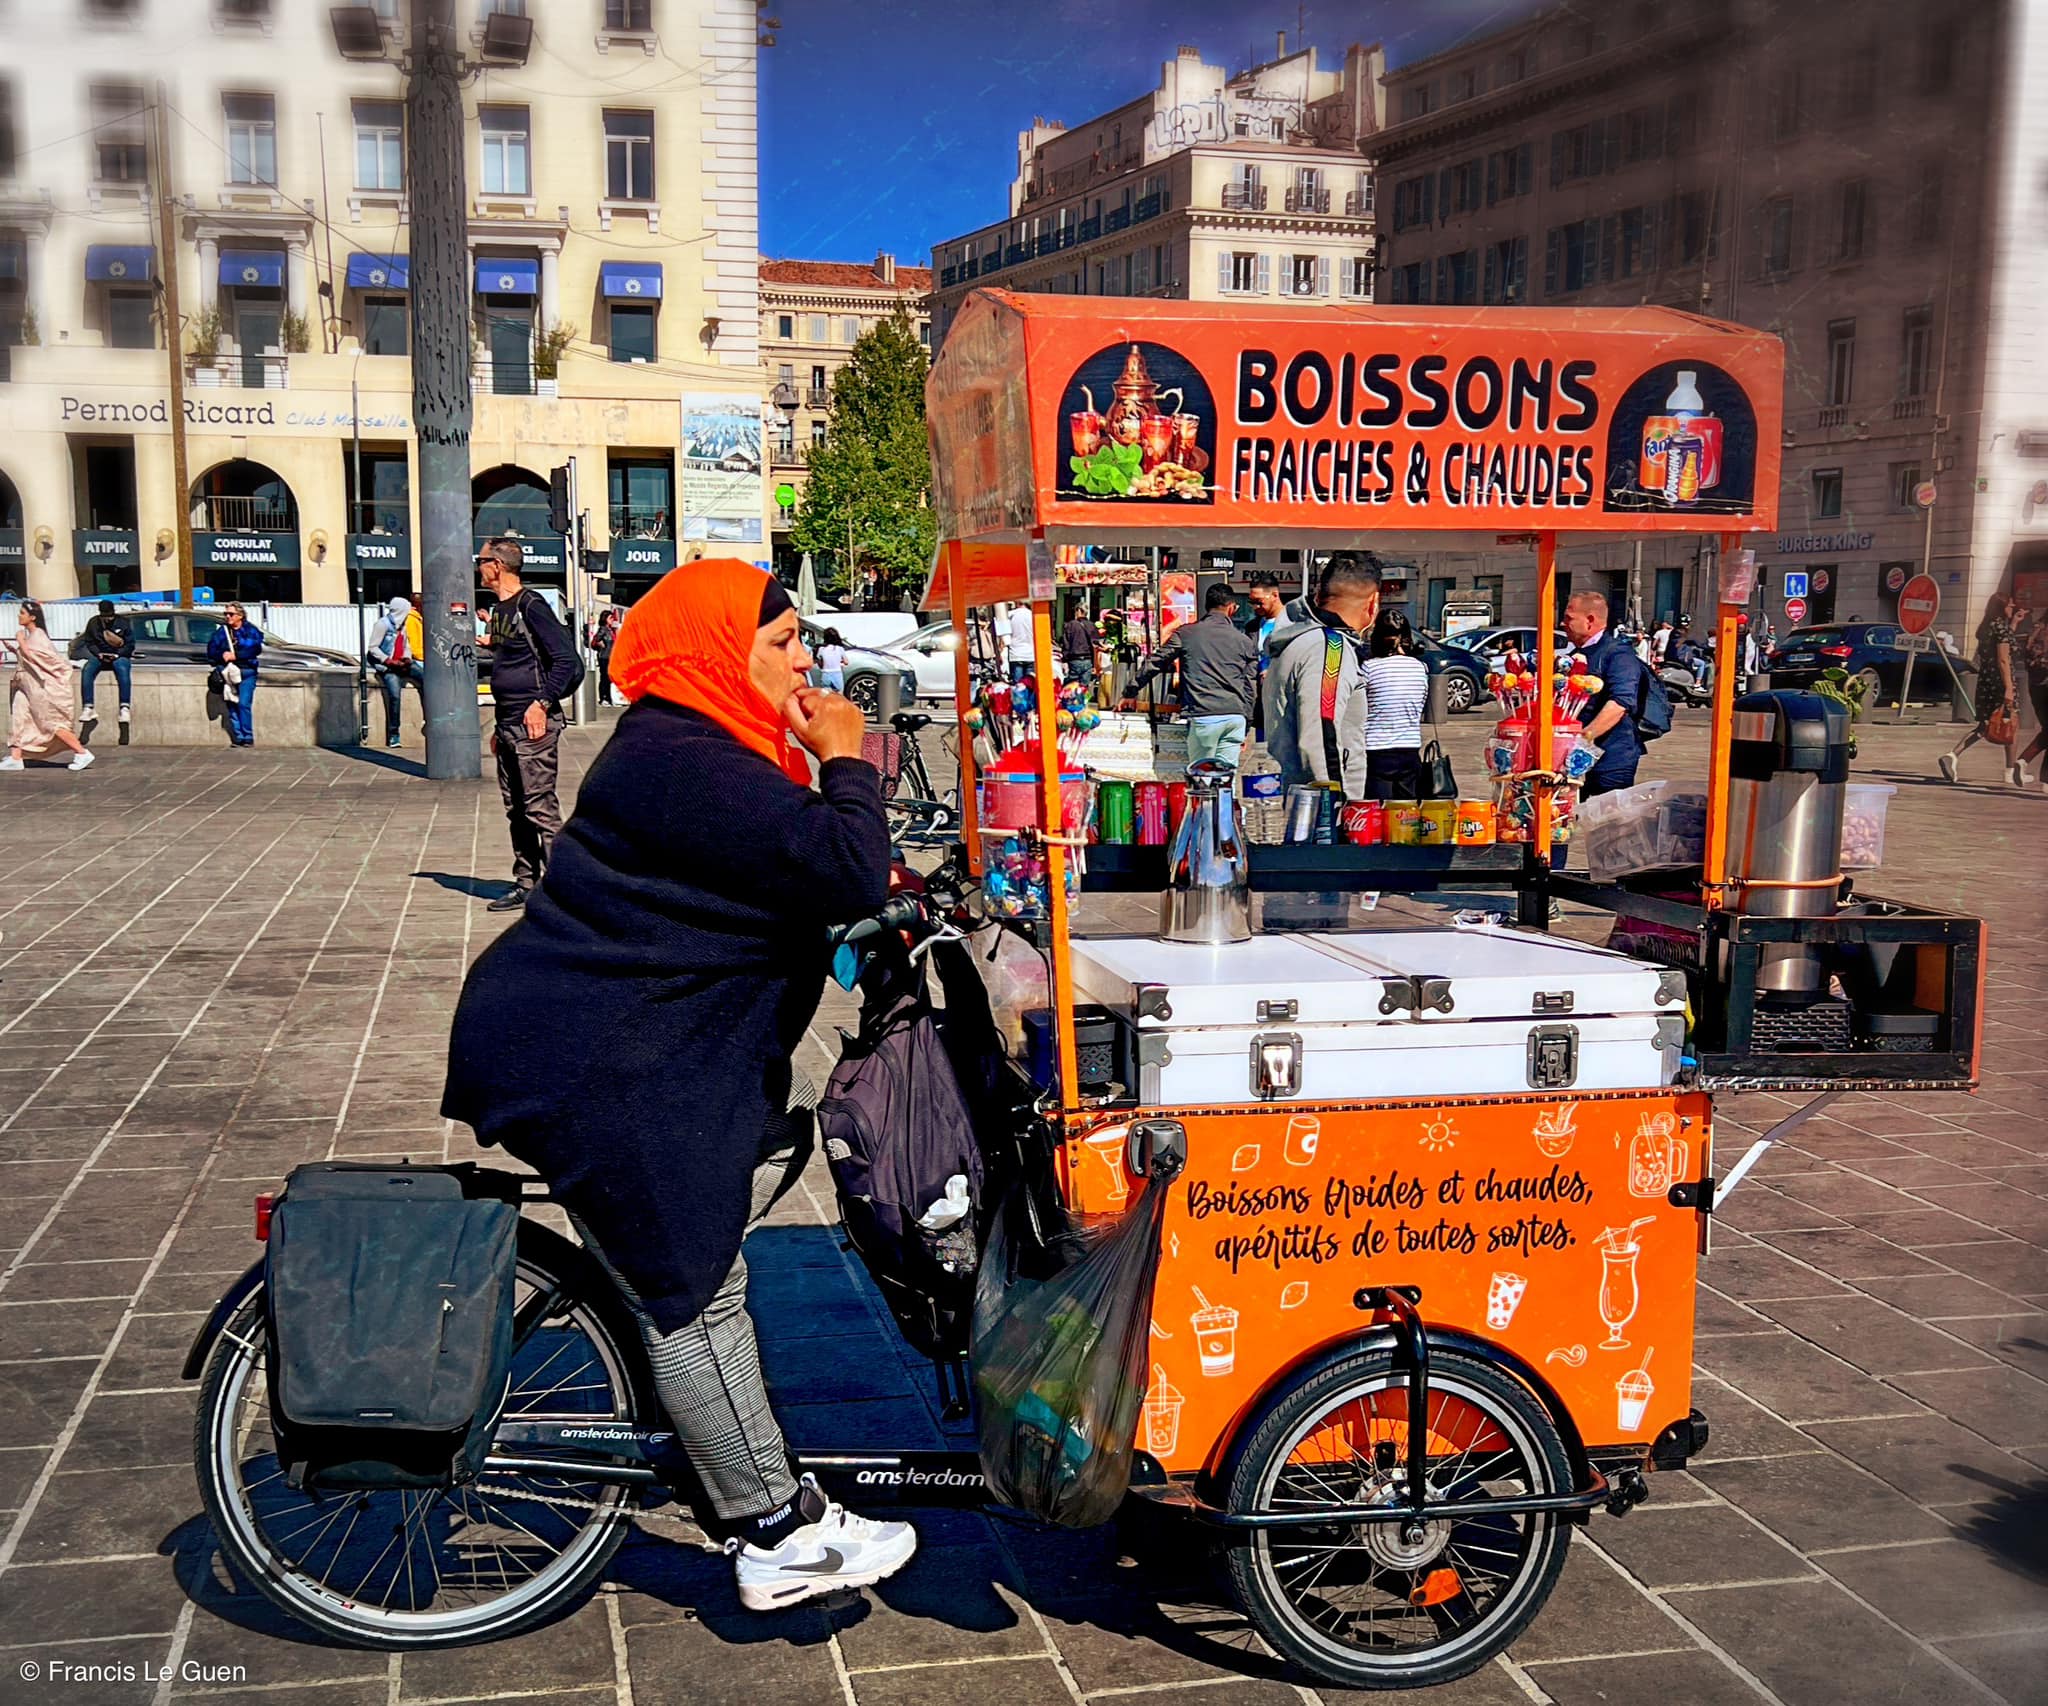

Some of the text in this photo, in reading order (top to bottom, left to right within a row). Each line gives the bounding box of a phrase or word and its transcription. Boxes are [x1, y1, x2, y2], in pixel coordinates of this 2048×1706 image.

[1236, 349, 1599, 434] BOISSONS
[61, 397, 275, 425] Pernod Ricard
[286, 410, 327, 426] Club
[1232, 437, 1594, 508] FRAICHES & CHAUDES
[85, 541, 129, 553] ATIPIK
[214, 538, 273, 550] CONSULAT
[1777, 532, 1872, 552] BURGER KING
[211, 552, 278, 563] DU PANAMA
[625, 550, 660, 563] JOUR
[1459, 820, 1484, 834] FANTA
[1187, 1163, 1593, 1220] Boissons froides et chaudes,
[1214, 1213, 1577, 1275] apéritifs de toutes sortes.
[856, 1467, 985, 1488] amsterdam
[758, 1502, 793, 1529] PUMA
